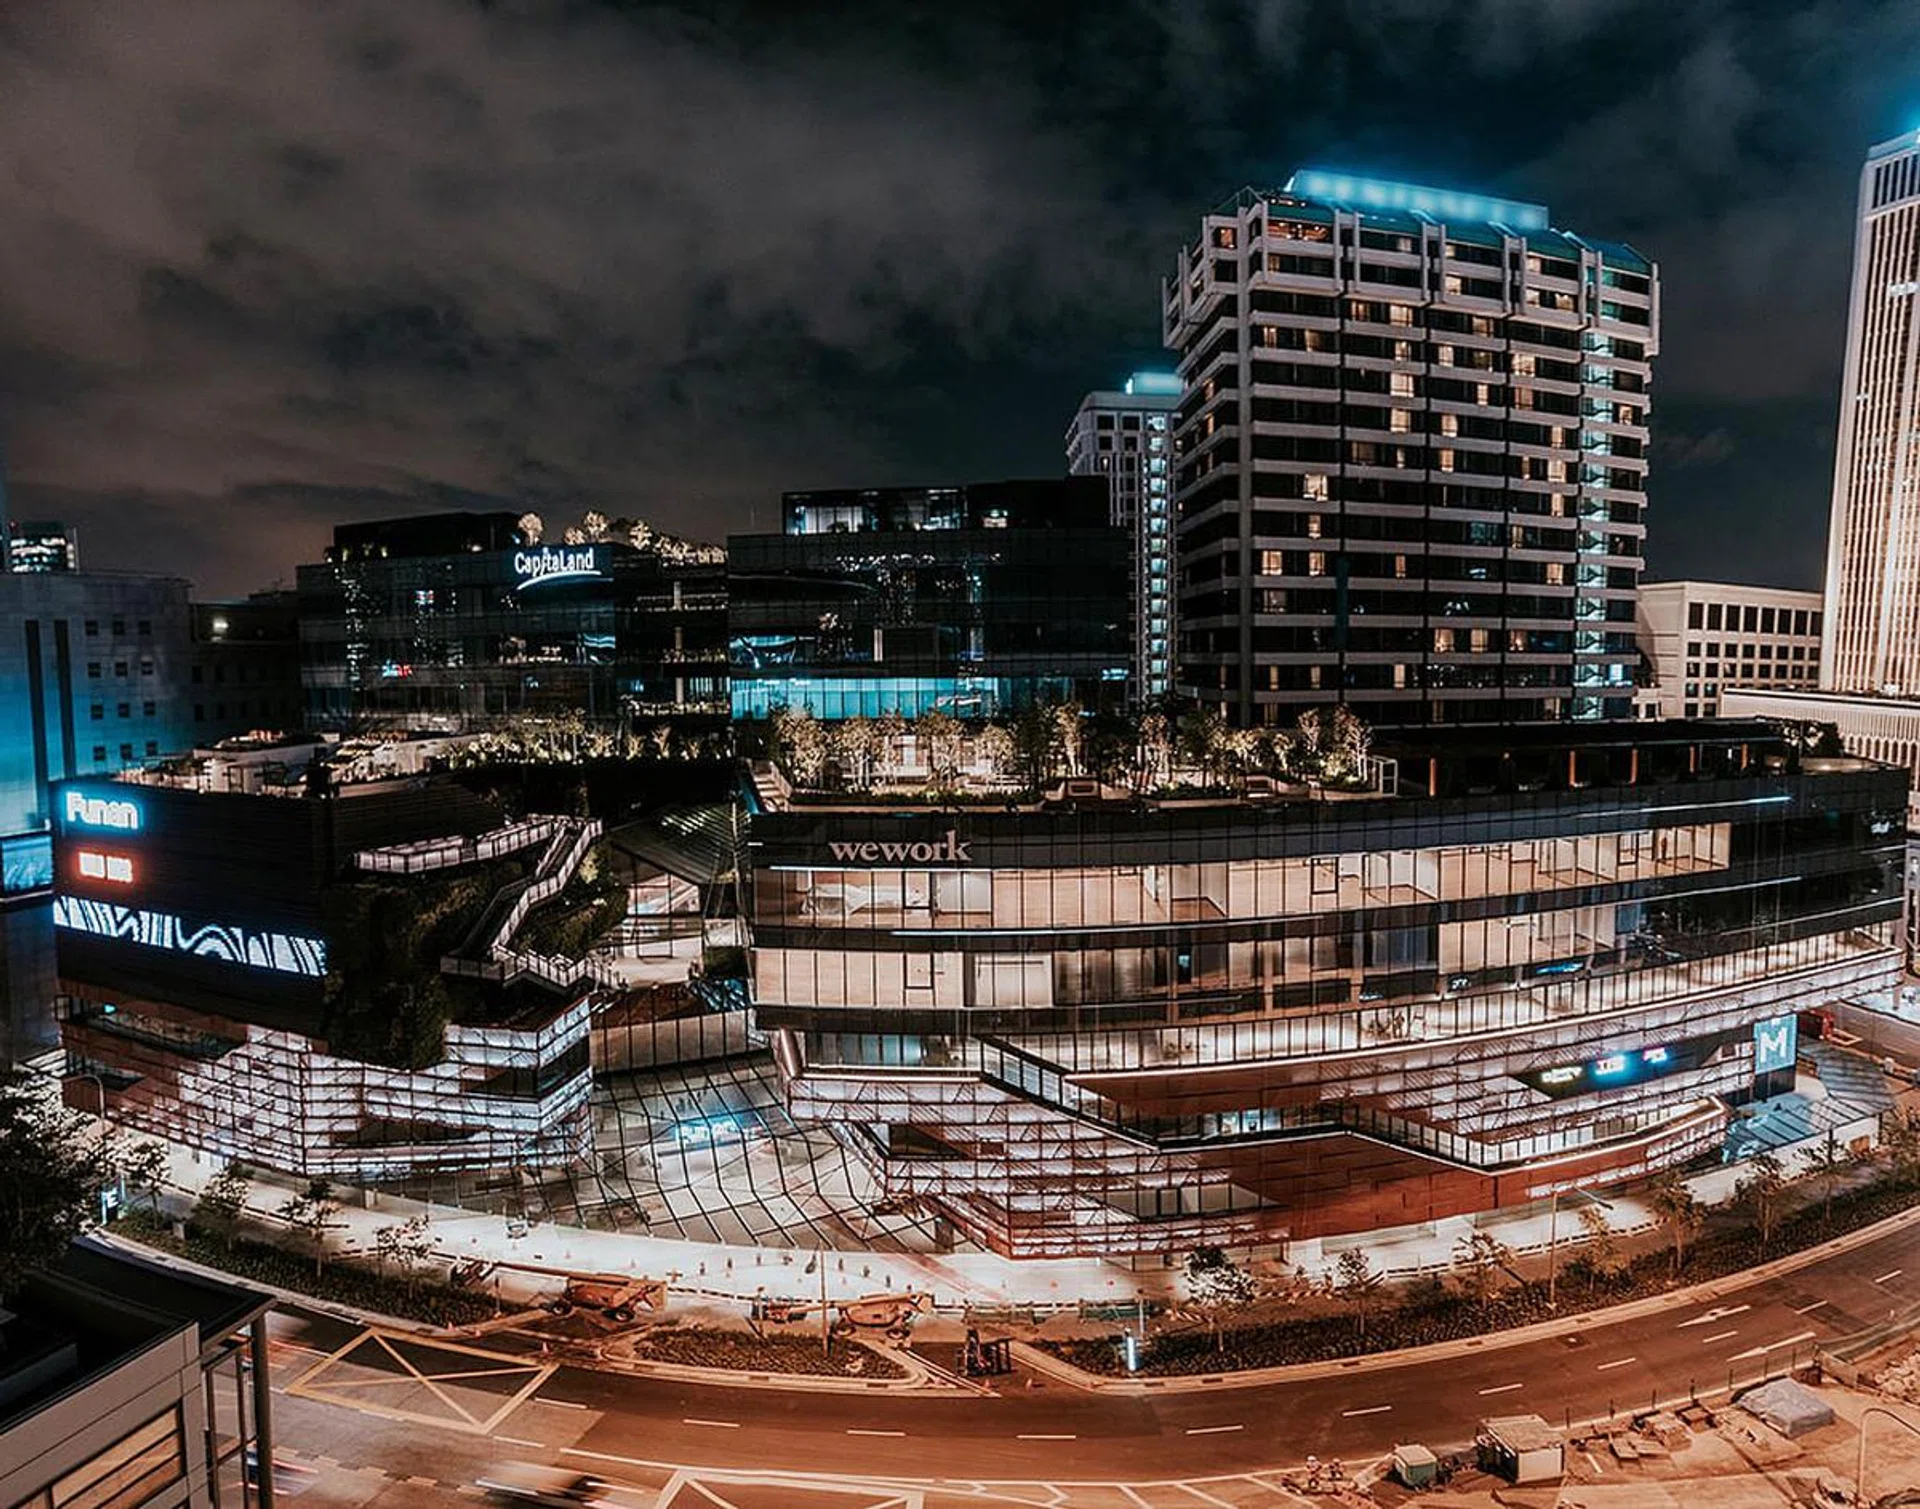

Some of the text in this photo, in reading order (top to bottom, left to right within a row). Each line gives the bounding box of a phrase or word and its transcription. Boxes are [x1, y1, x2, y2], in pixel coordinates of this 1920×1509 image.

[514, 546, 595, 577] CapitaLand
[66, 791, 138, 829] Funan
[828, 829, 972, 862] wework
